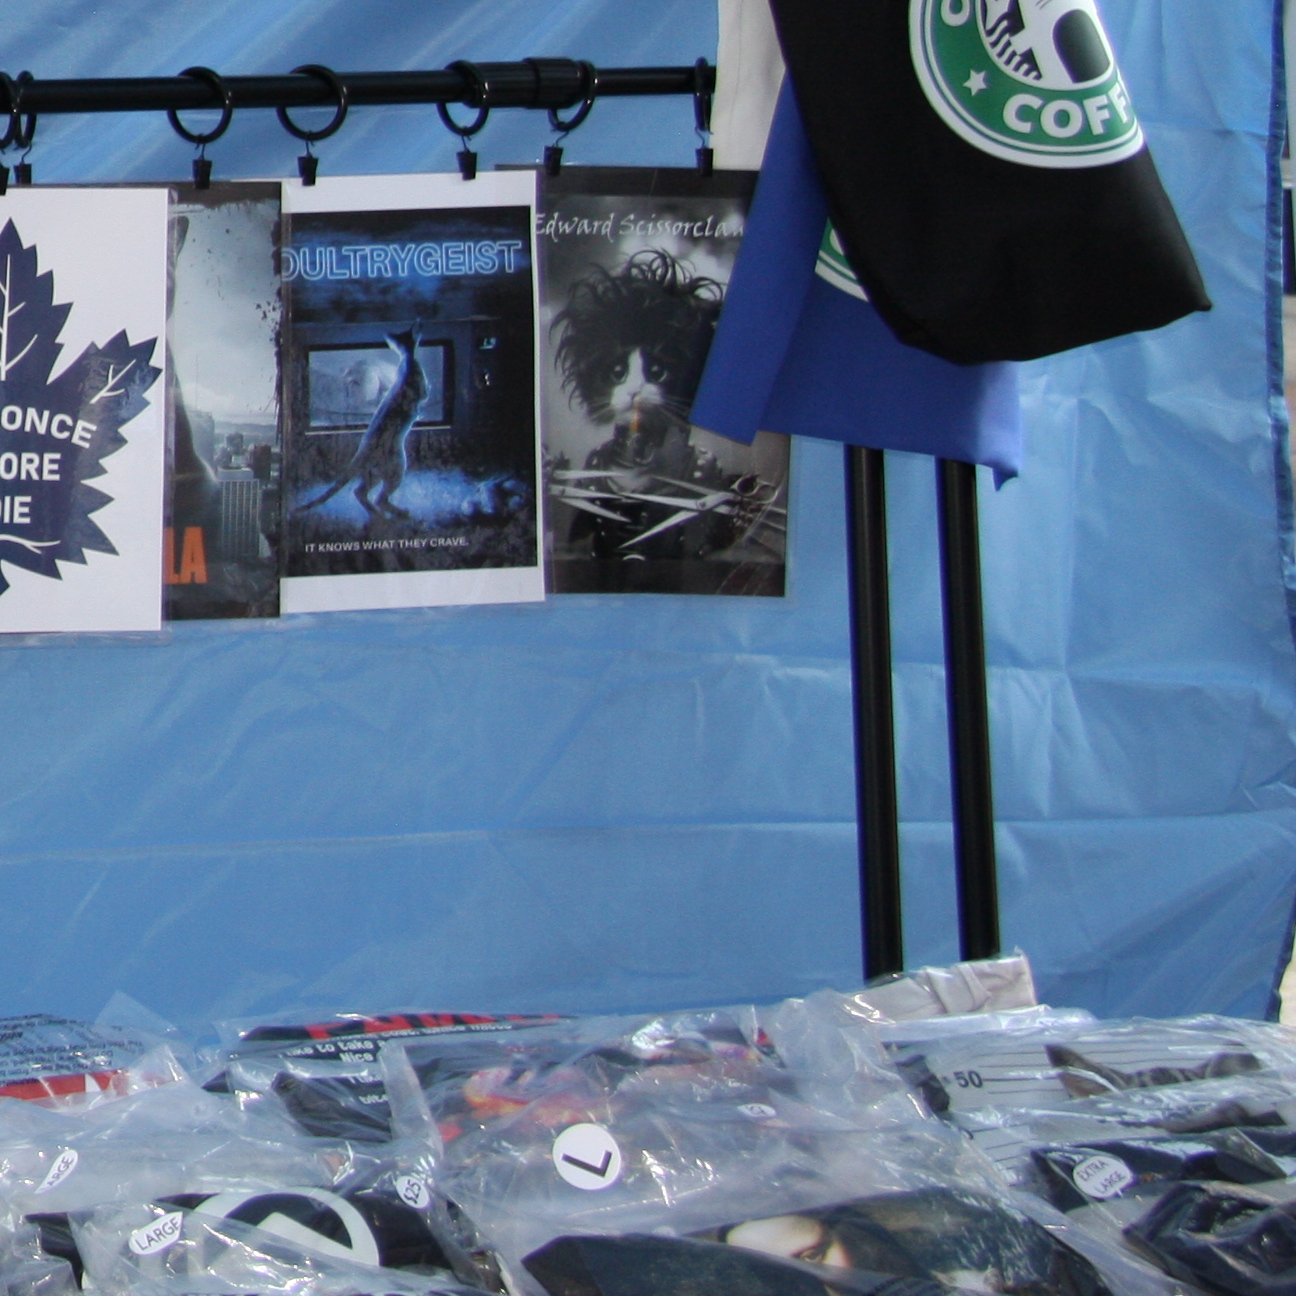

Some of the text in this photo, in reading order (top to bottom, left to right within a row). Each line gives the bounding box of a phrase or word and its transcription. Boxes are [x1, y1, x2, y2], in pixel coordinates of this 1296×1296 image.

[0, 405, 97, 449] ONCE
[305, 536, 469, 553] IT KNOWS WHAT THEY CRAVE.
[953, 1070, 983, 1089] 50
[1078, 1160, 1107, 1182] EXTRA
[1094, 1171, 1125, 1195] LARGE
[135, 1217, 181, 1251] LARGE
